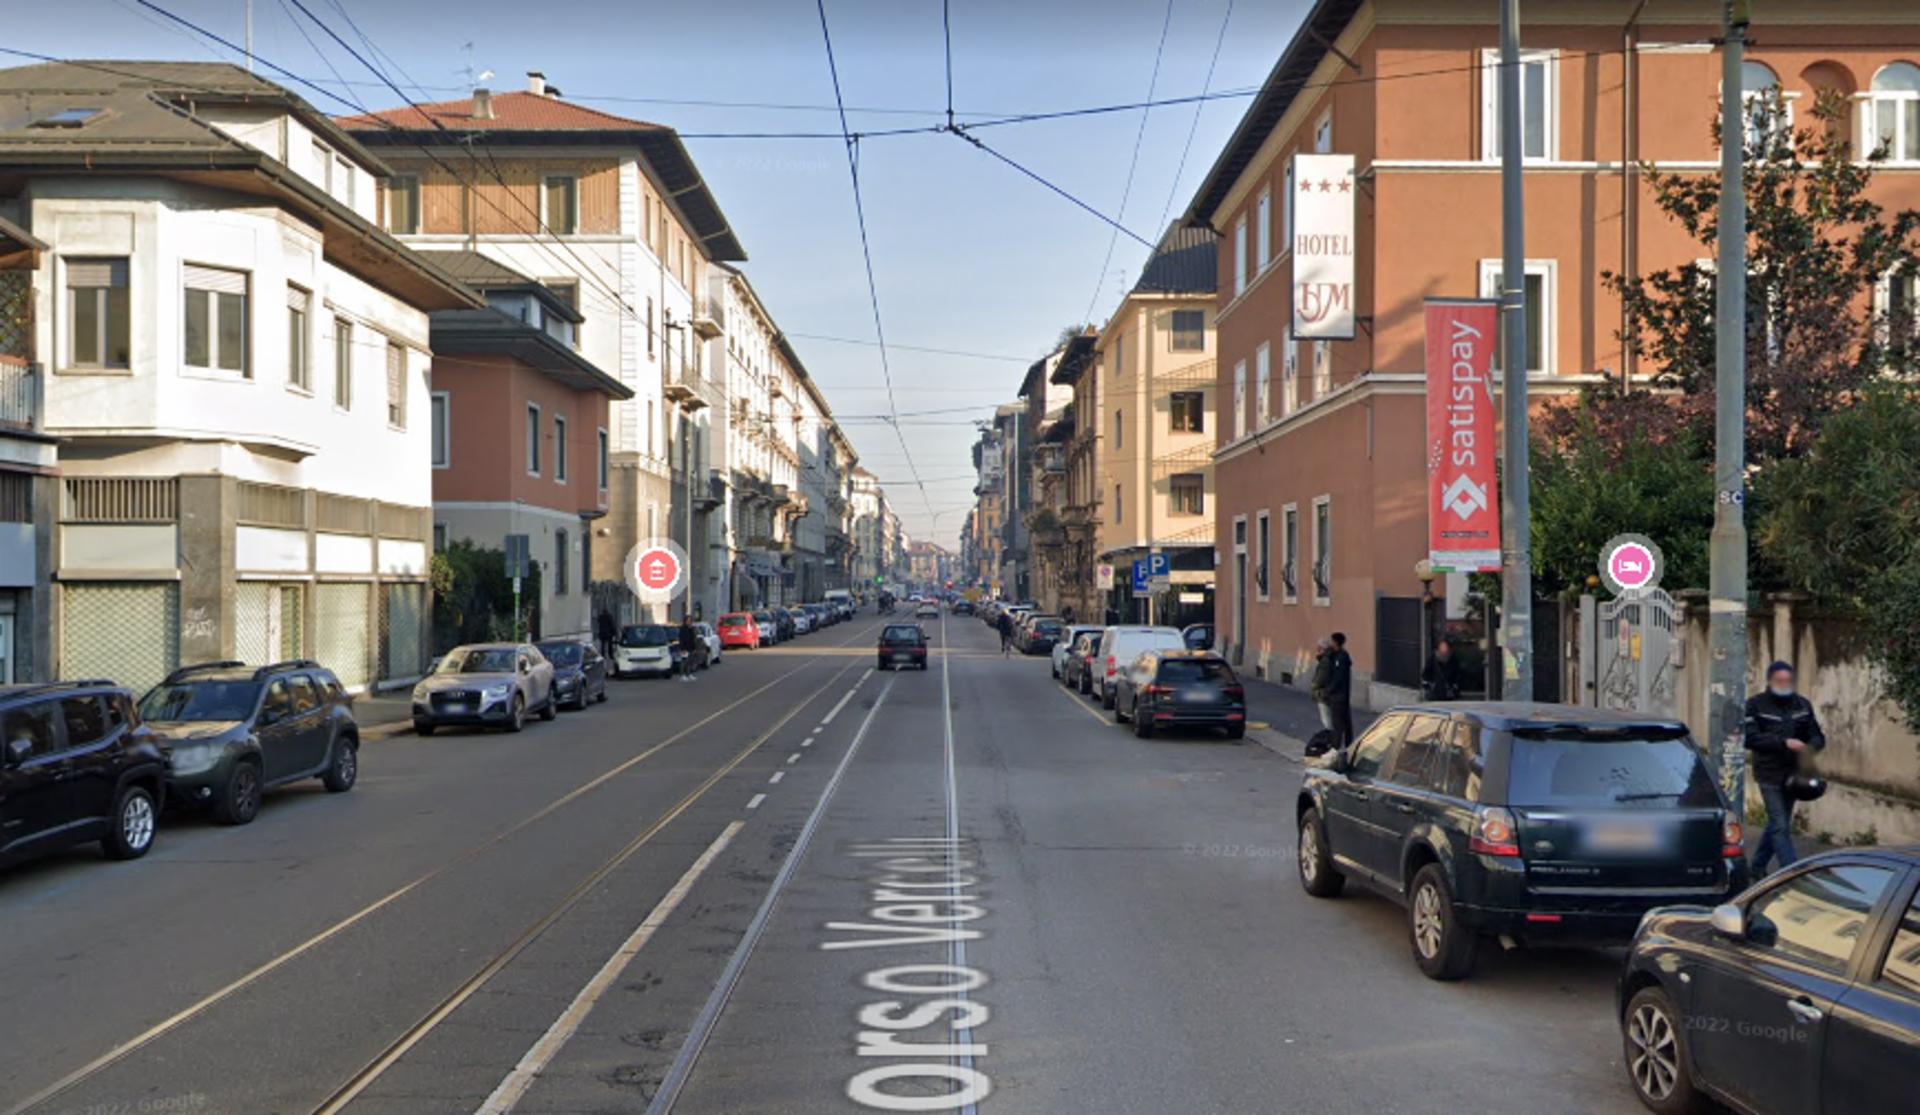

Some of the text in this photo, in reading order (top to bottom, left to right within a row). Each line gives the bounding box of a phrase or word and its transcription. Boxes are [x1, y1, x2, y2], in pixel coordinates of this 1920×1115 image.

[1296, 234, 1352, 256] HOTEL
[1447, 319, 1483, 467] satispay
[1151, 556, 1165, 574] P
